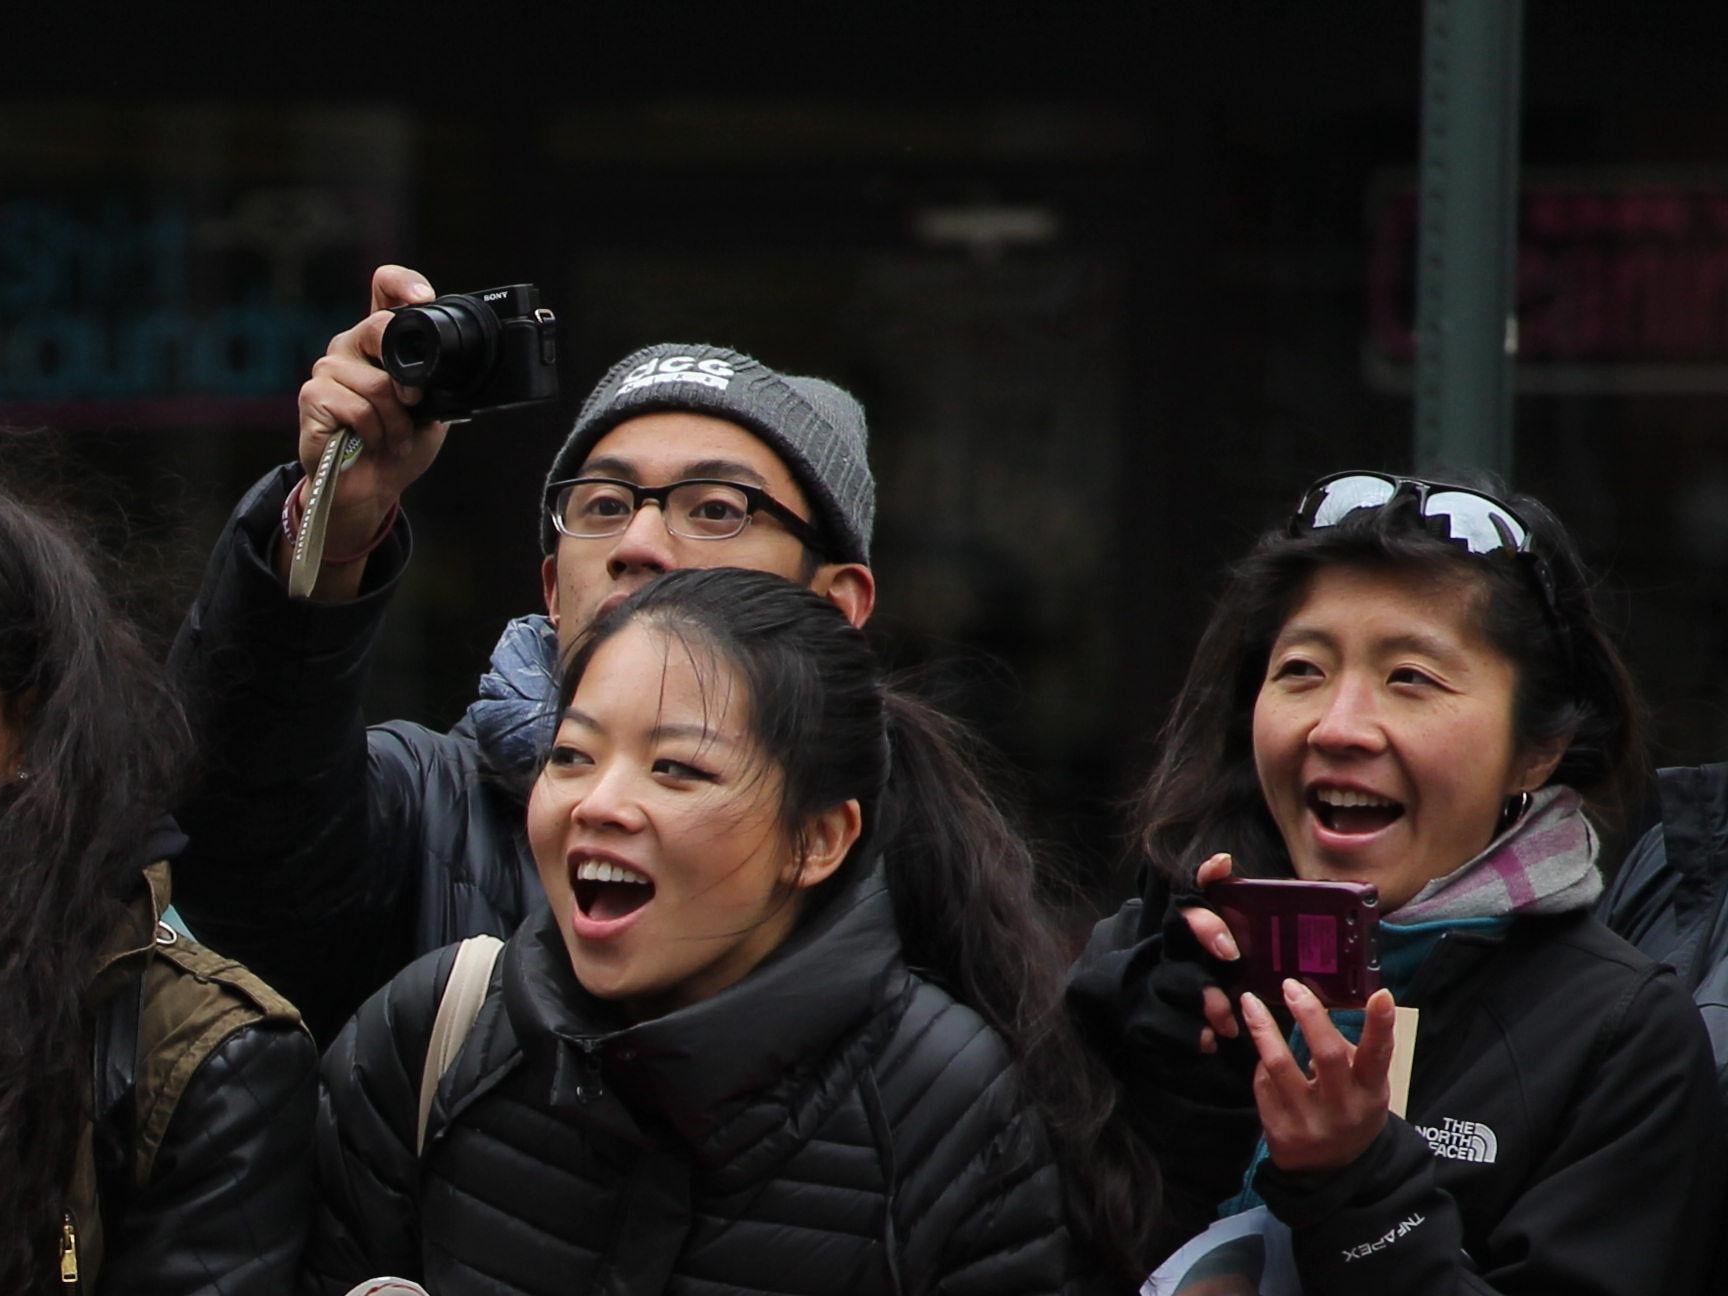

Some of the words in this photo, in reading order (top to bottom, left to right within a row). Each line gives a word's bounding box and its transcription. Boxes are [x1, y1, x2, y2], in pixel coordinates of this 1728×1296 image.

[483, 291, 509, 302] SONY
[1443, 1117, 1475, 1135] THE
[1414, 1125, 1472, 1147] NORTH
[1428, 1141, 1468, 1160] FACE
